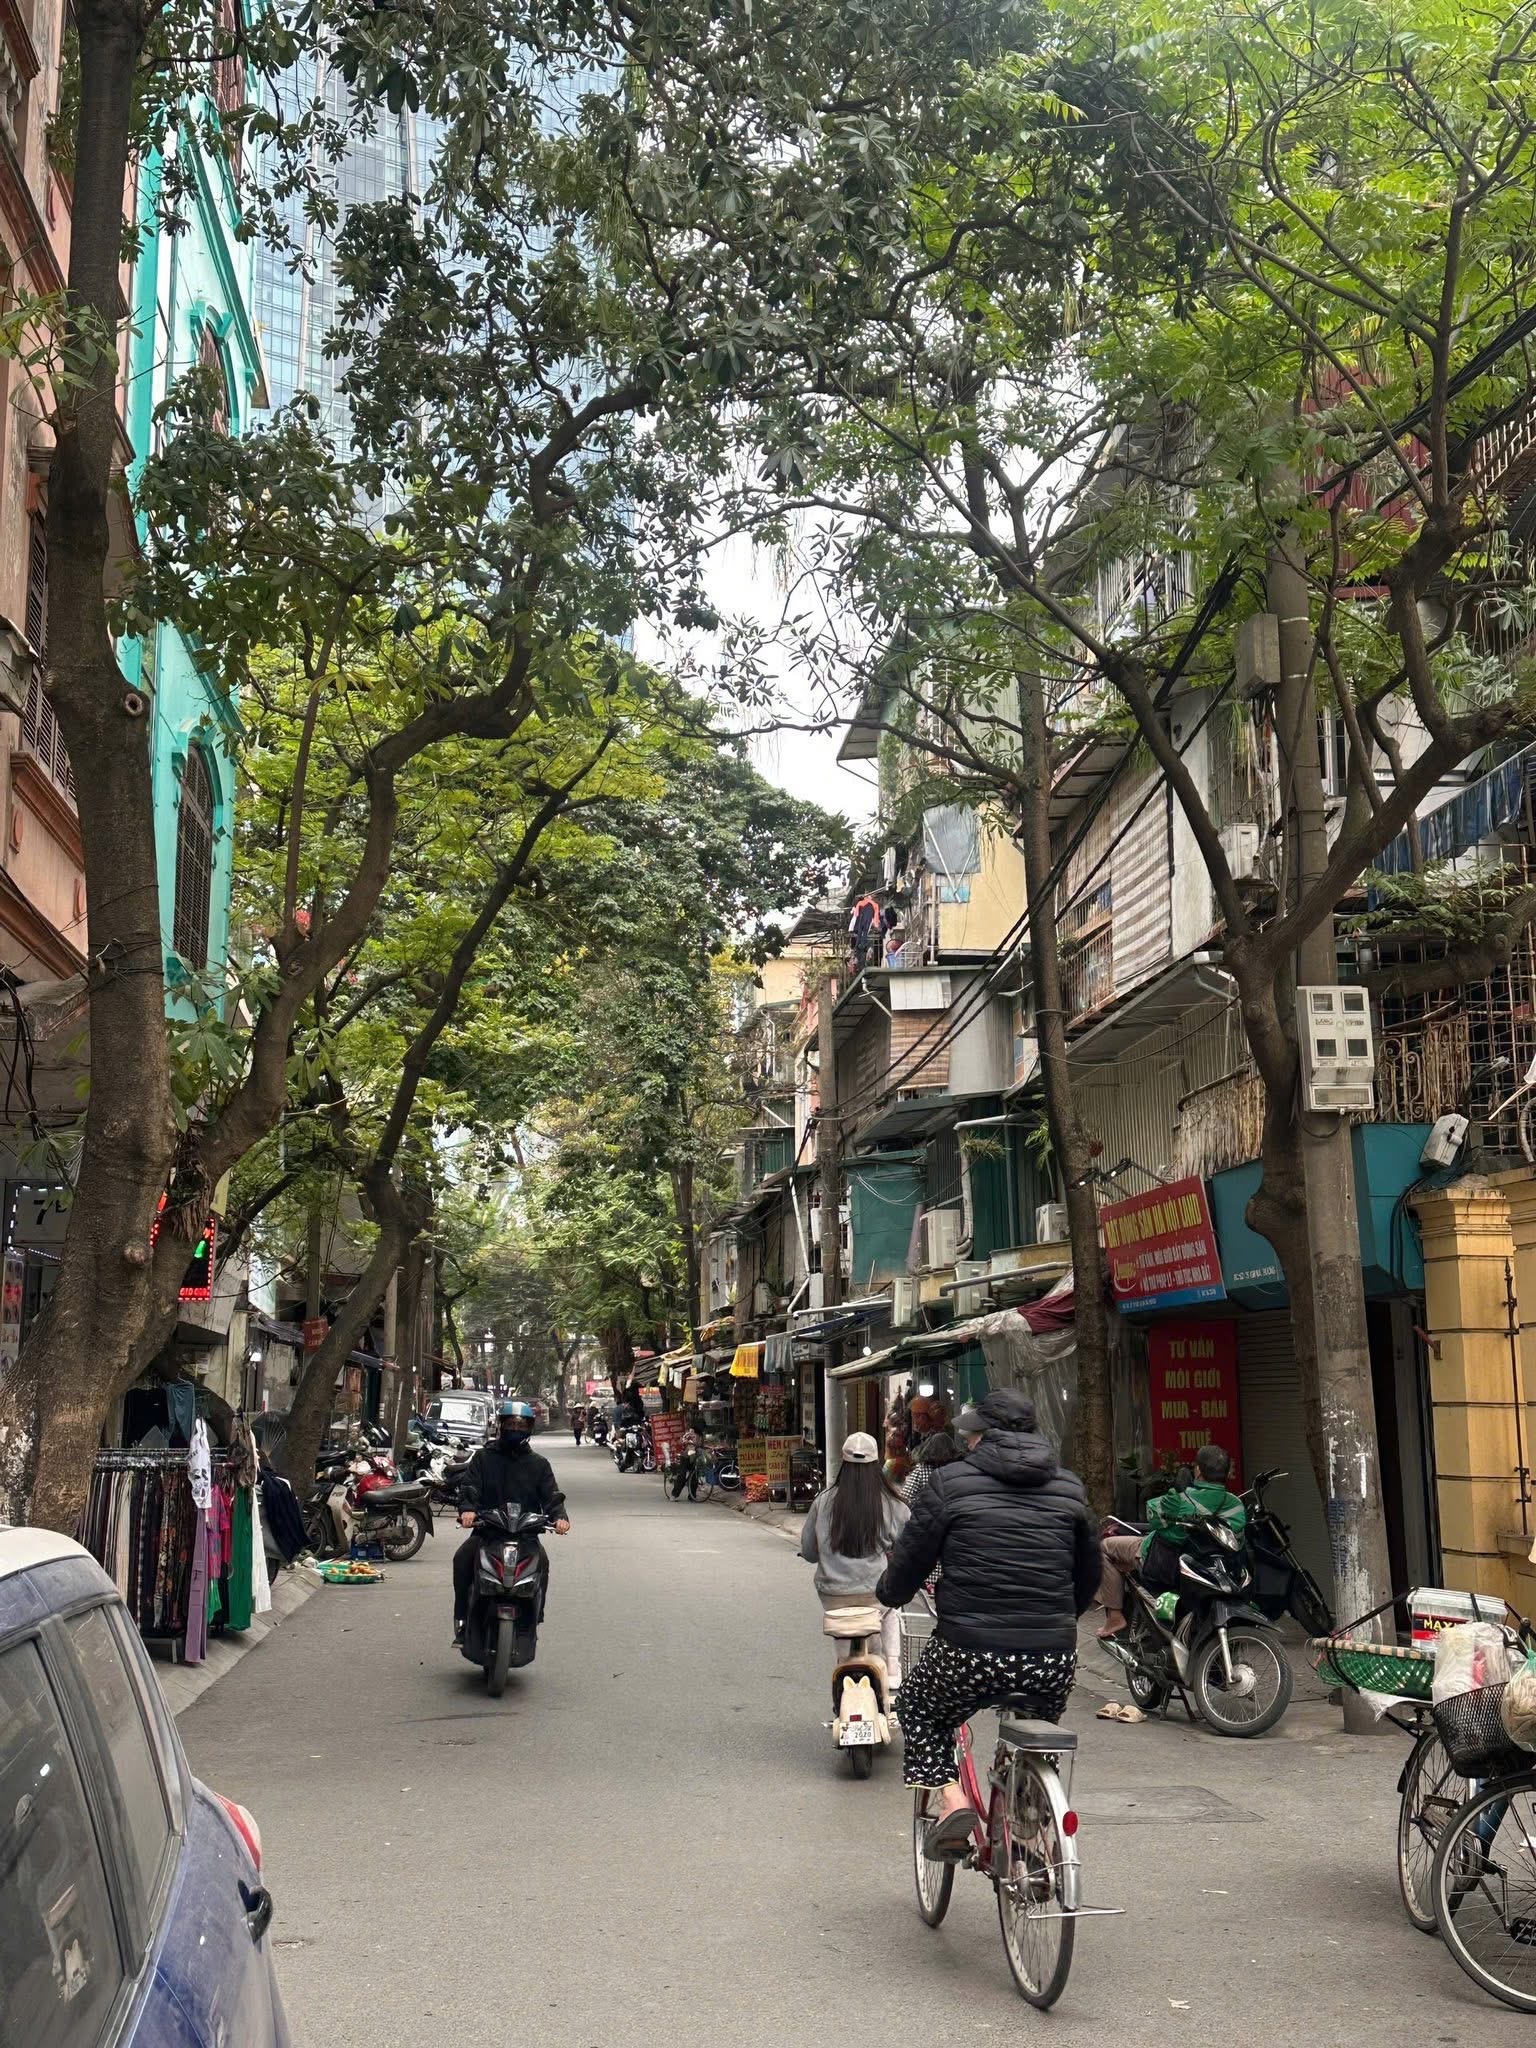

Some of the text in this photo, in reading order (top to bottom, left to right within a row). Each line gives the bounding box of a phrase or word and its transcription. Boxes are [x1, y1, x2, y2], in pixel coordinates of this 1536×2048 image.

[1138, 1203, 1155, 1239] SẢN
[1151, 1200, 1166, 1235] HÀ
[1163, 1195, 1180, 1236] NỘI
[1179, 1193, 1202, 1228] LAND
[1168, 1336, 1214, 1359] TƯ VẤN
[1165, 1367, 1221, 1389] MÔI GIỚI
[1161, 1400, 1190, 1419] MUA
[1201, 1396, 1228, 1418] BÁN
